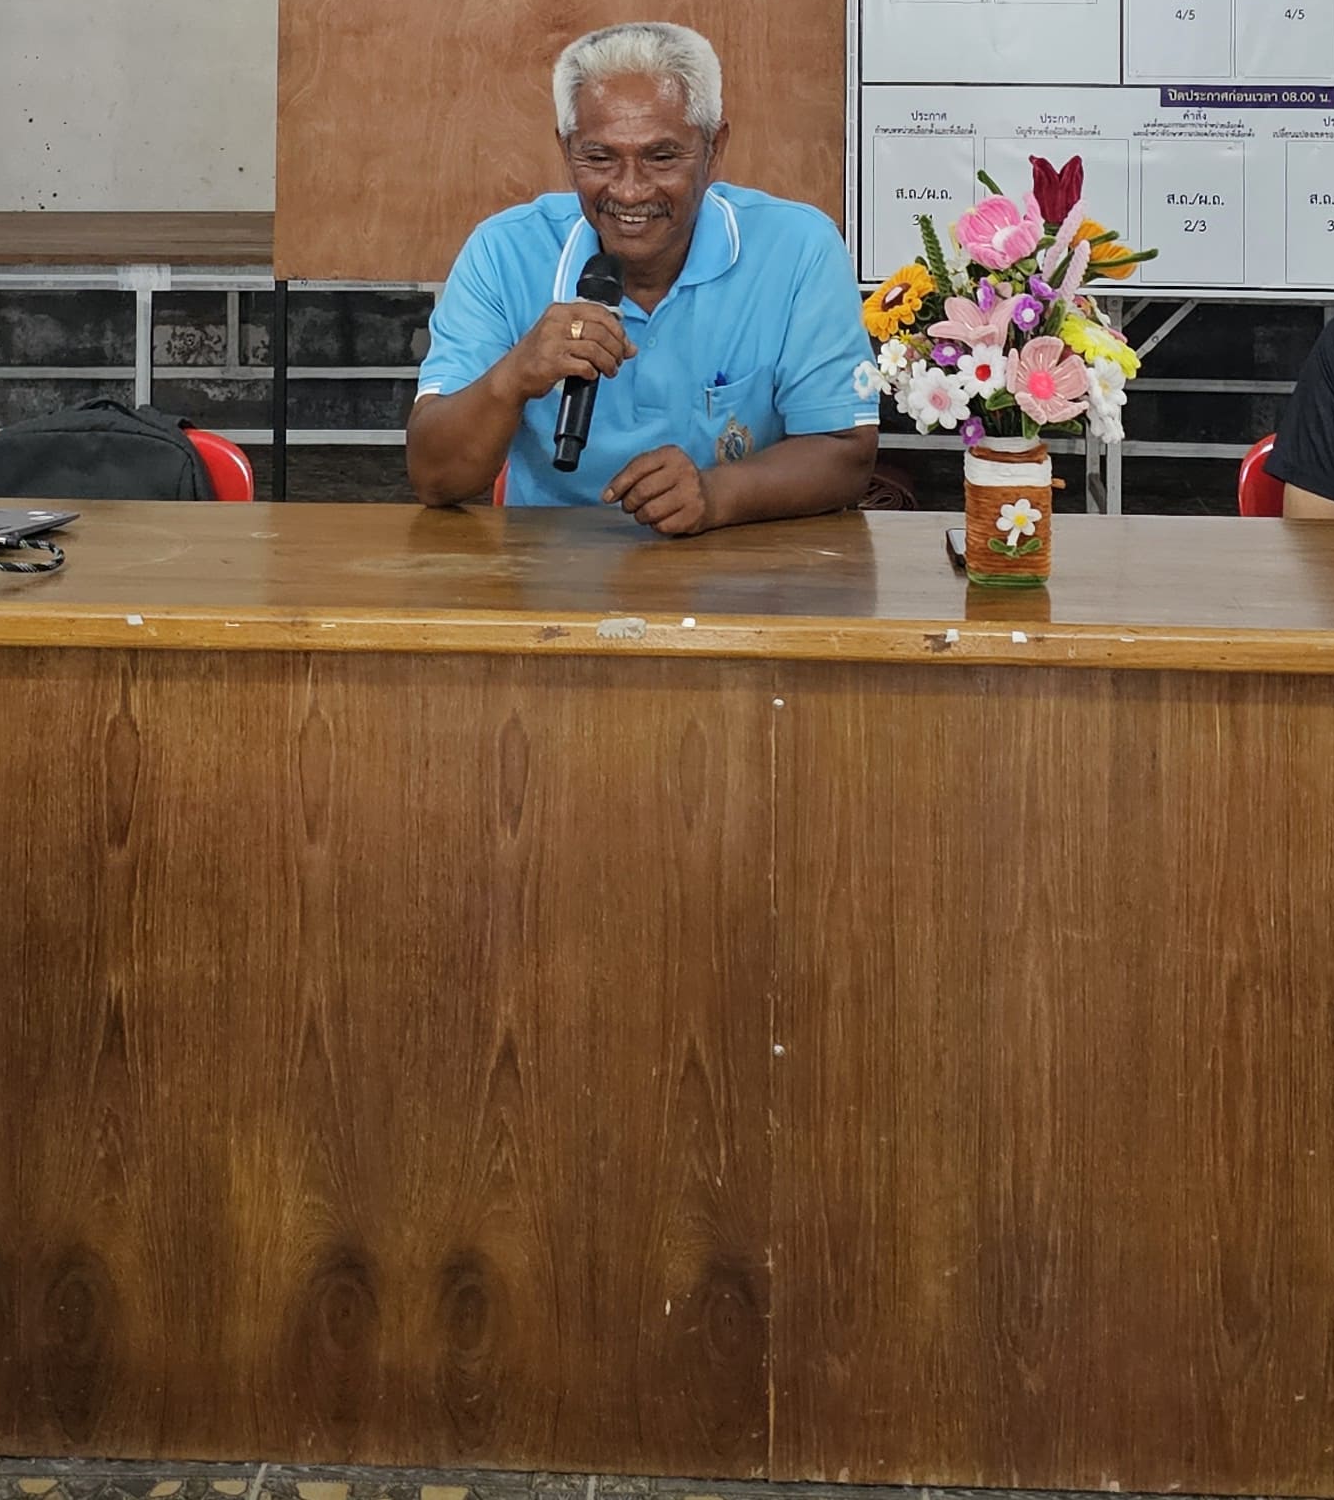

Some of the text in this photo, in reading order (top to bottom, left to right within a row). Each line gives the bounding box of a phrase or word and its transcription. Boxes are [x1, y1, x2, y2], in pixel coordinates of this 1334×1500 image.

[1174, 9, 1196, 21] 4/5
[1284, 8, 1306, 21] 4/5
[1166, 88, 1332, 103] ปิดประกาศก่อนเวลา 08.00 น.
[910, 109, 948, 125] ประกาศ
[1039, 112, 1076, 124] ประกาศ
[895, 186, 952, 200] ส.ถ./ผ.ถ.
[1166, 192, 1225, 206] ส.ถ./ผ.ถ.
[1183, 219, 1207, 233] 2/3
